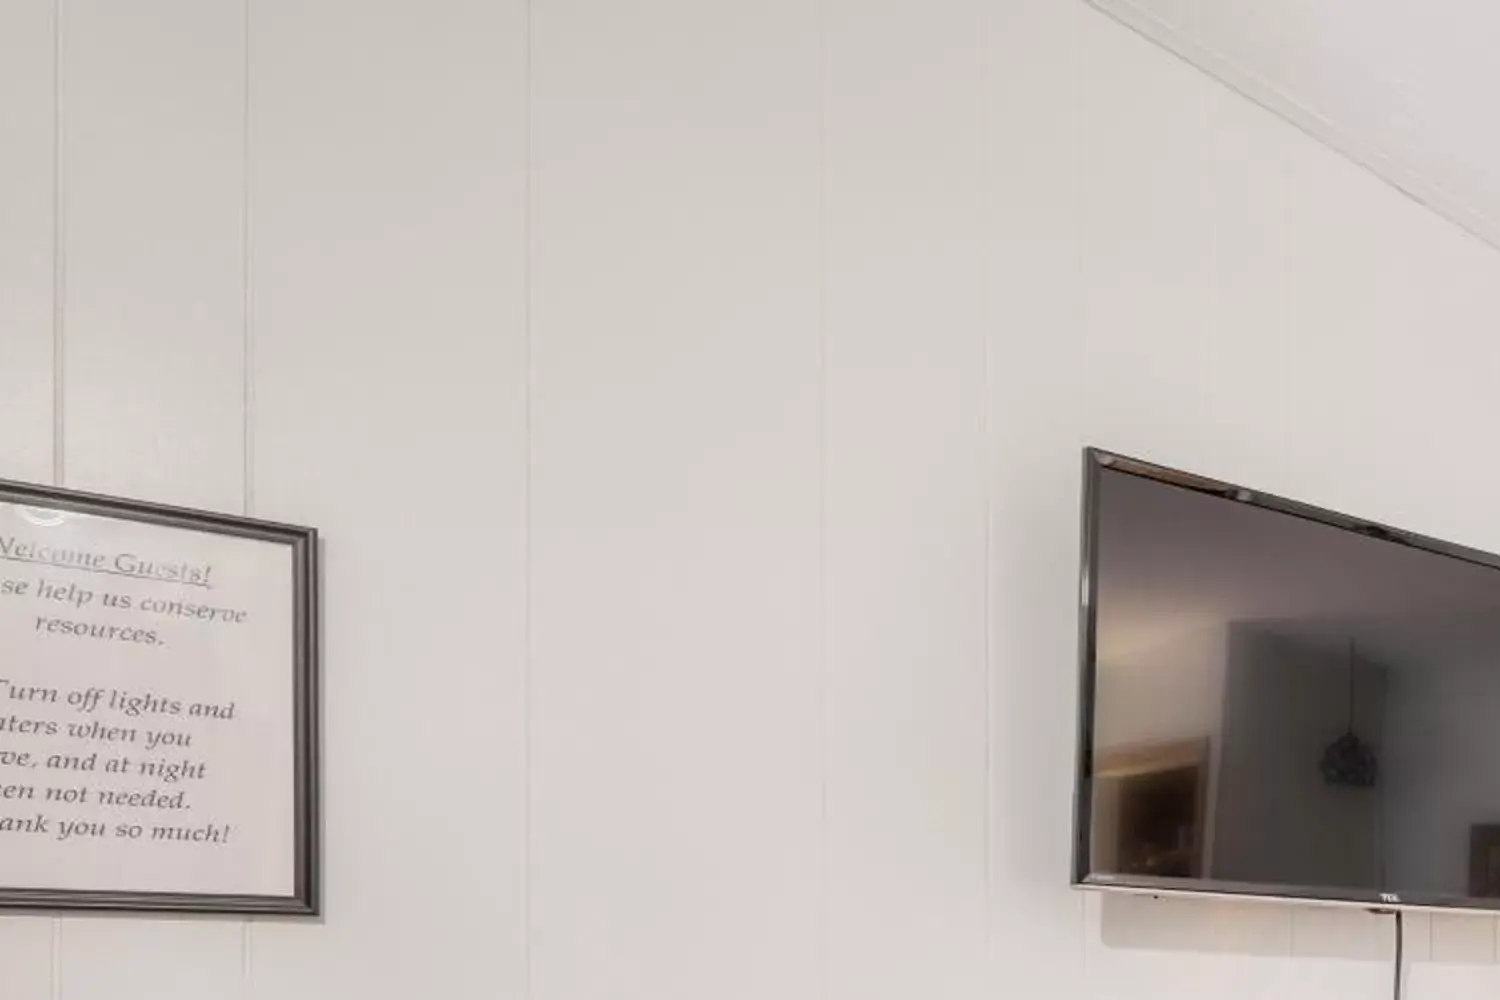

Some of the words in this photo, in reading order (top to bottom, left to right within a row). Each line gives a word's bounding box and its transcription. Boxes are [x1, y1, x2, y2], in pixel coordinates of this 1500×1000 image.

[114, 553, 212, 583] Guests!
[36, 578, 93, 608] help
[102, 592, 131, 610] us
[140, 597, 248, 624] conserve
[35, 615, 165, 646] resources.
[67, 687, 105, 713] off
[109, 690, 182, 717] lights
[189, 702, 235, 720] and
[68, 721, 137, 743] when
[145, 730, 192, 751] you
[47, 752, 97, 772] and
[105, 756, 129, 774] at
[140, 757, 207, 784] night
[0, 784, 34, 801] en
[46, 786, 88, 804] not
[99, 789, 191, 810] needed.
[57, 819, 106, 841] you
[115, 822, 143, 840] so
[151, 823, 231, 845] much!
